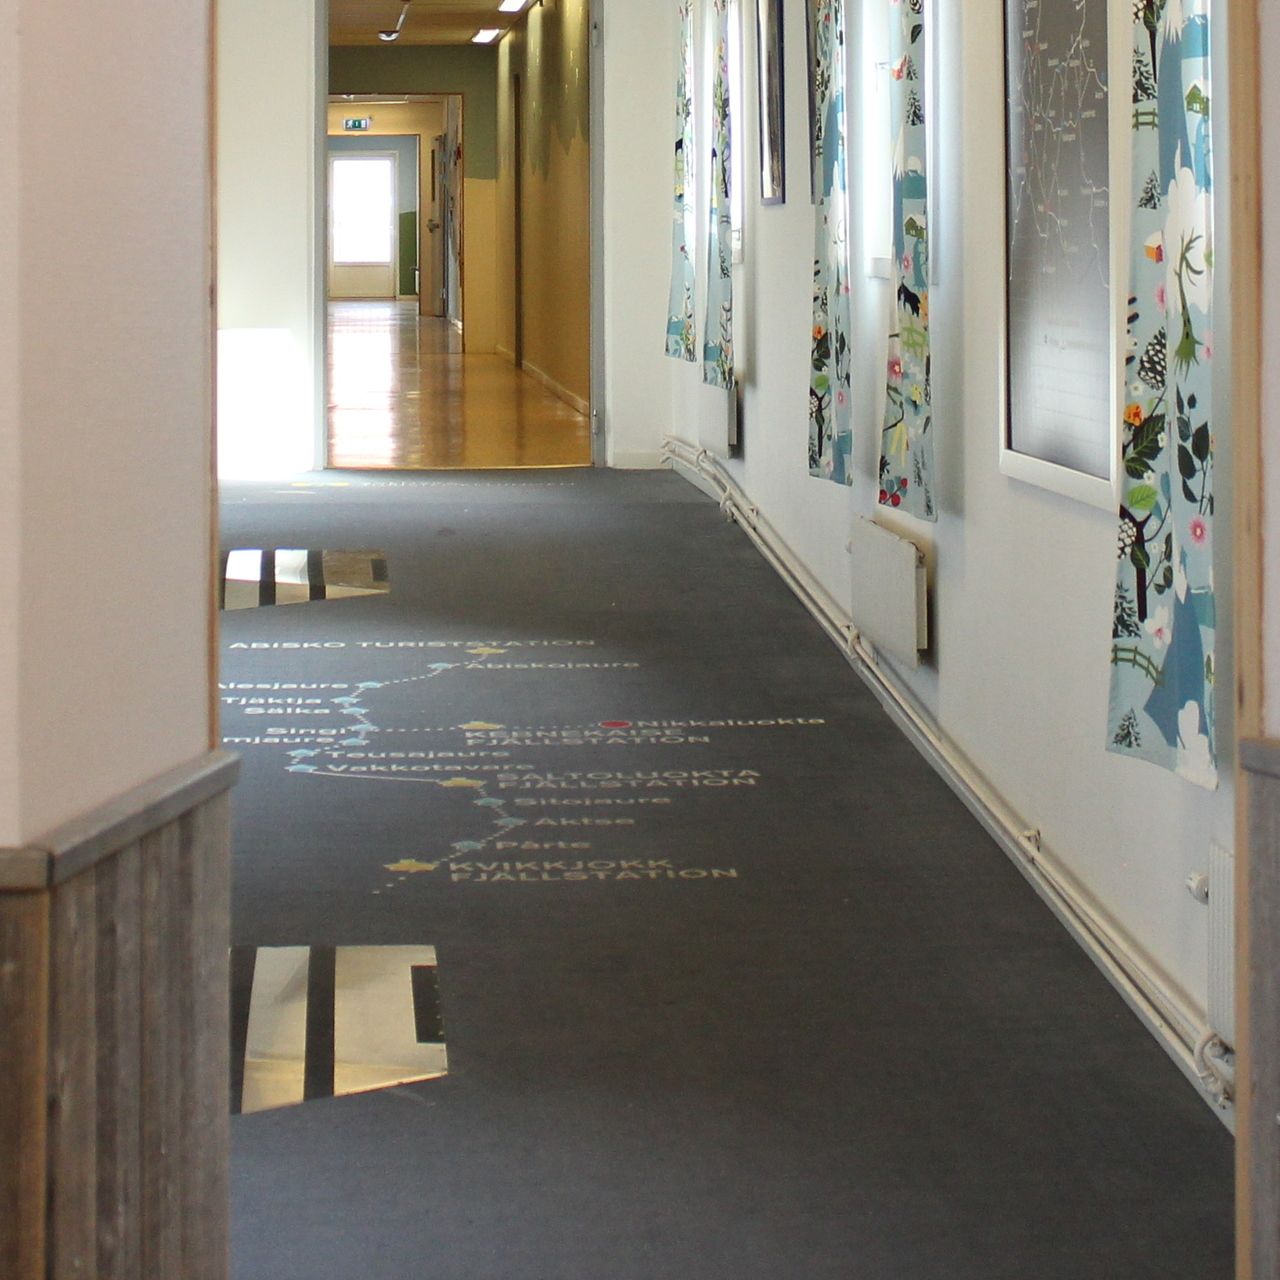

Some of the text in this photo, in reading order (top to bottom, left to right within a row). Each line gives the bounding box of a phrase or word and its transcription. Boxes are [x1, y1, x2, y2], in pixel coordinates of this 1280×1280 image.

[355, 640, 595, 648] TURISTSTATION
[465, 662, 640, 670] Abiskojaure
[636, 718, 826, 728] Nikkaluokta
[464, 729, 683, 738] KEBNEKAISE
[222, 737, 335, 745] mjaure
[324, 751, 511, 759] Teusajaure
[326, 763, 536, 772] Vakkotavare
[497, 769, 761, 781] SALTOLUOKTA
[514, 798, 672, 807] Sitojaure
[534, 817, 636, 826] Aktse
[449, 860, 673, 872] KVIKKJOKK
